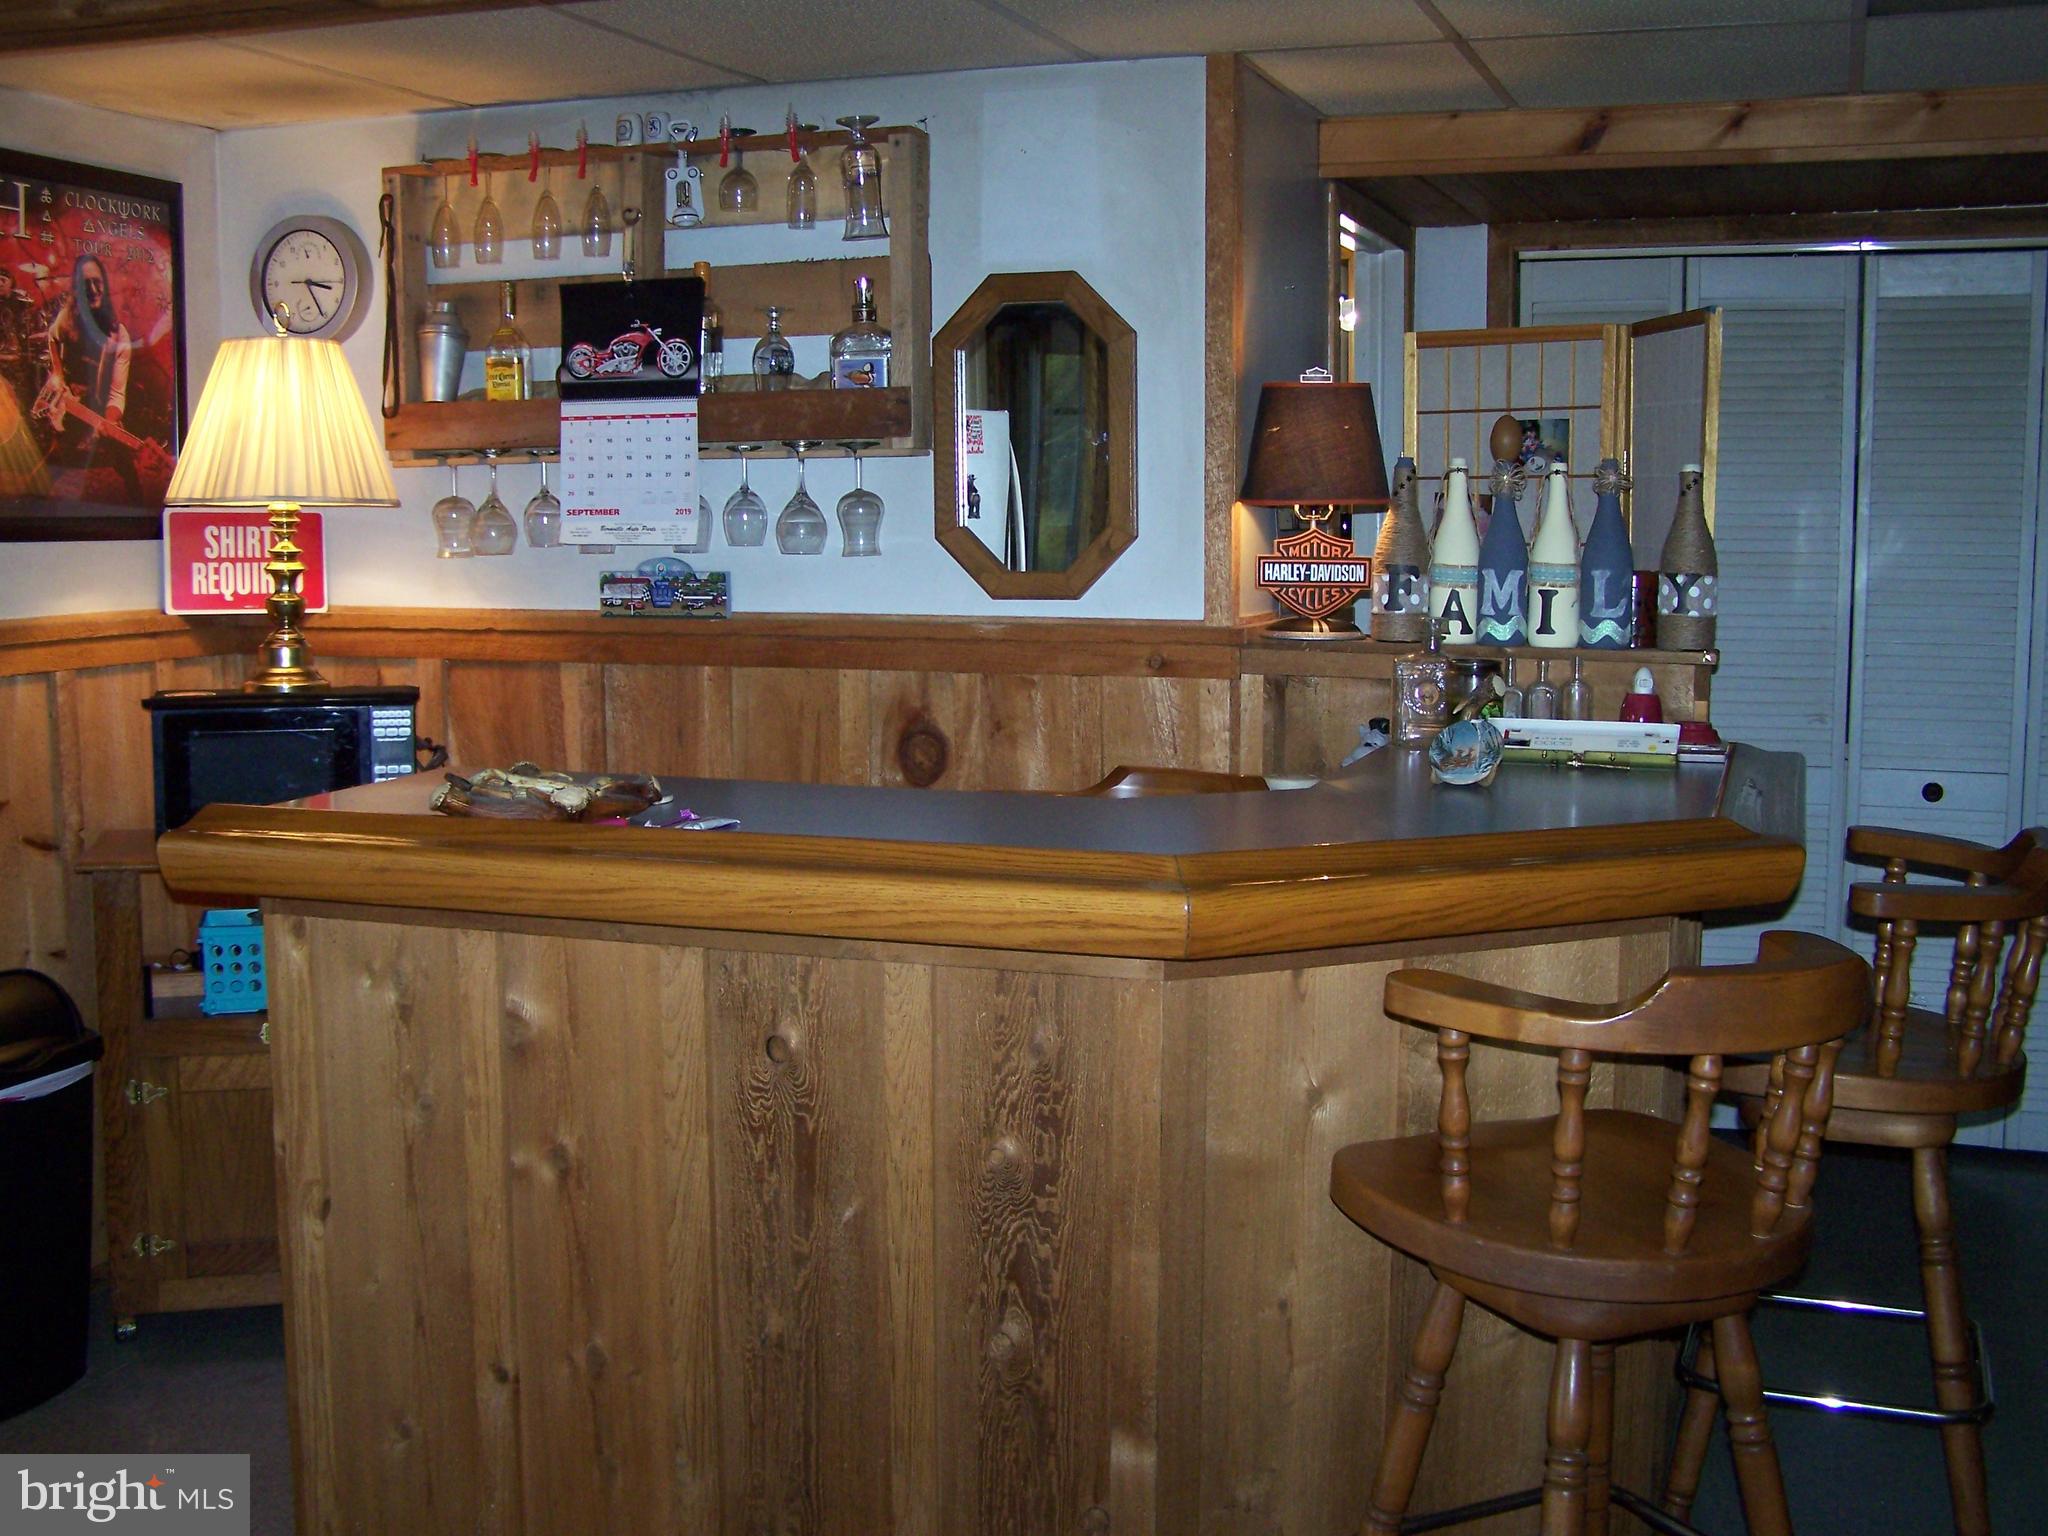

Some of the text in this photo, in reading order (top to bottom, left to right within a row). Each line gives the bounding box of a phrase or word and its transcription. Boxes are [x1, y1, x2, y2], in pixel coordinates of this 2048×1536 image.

[65, 191, 161, 222] CLOCKWORK
[83, 219, 145, 241] ANGELS
[73, 238, 112, 257] TOUR
[127, 247, 154, 265] 2012
[566, 508, 692, 517] SEPTEMBER 2019
[1288, 540, 1342, 558] MOTOR
[191, 561, 304, 601] REQUIR
[1264, 562, 1365, 583] HARLEY-DAVIDSON
[1287, 587, 1341, 610] CYCLES
